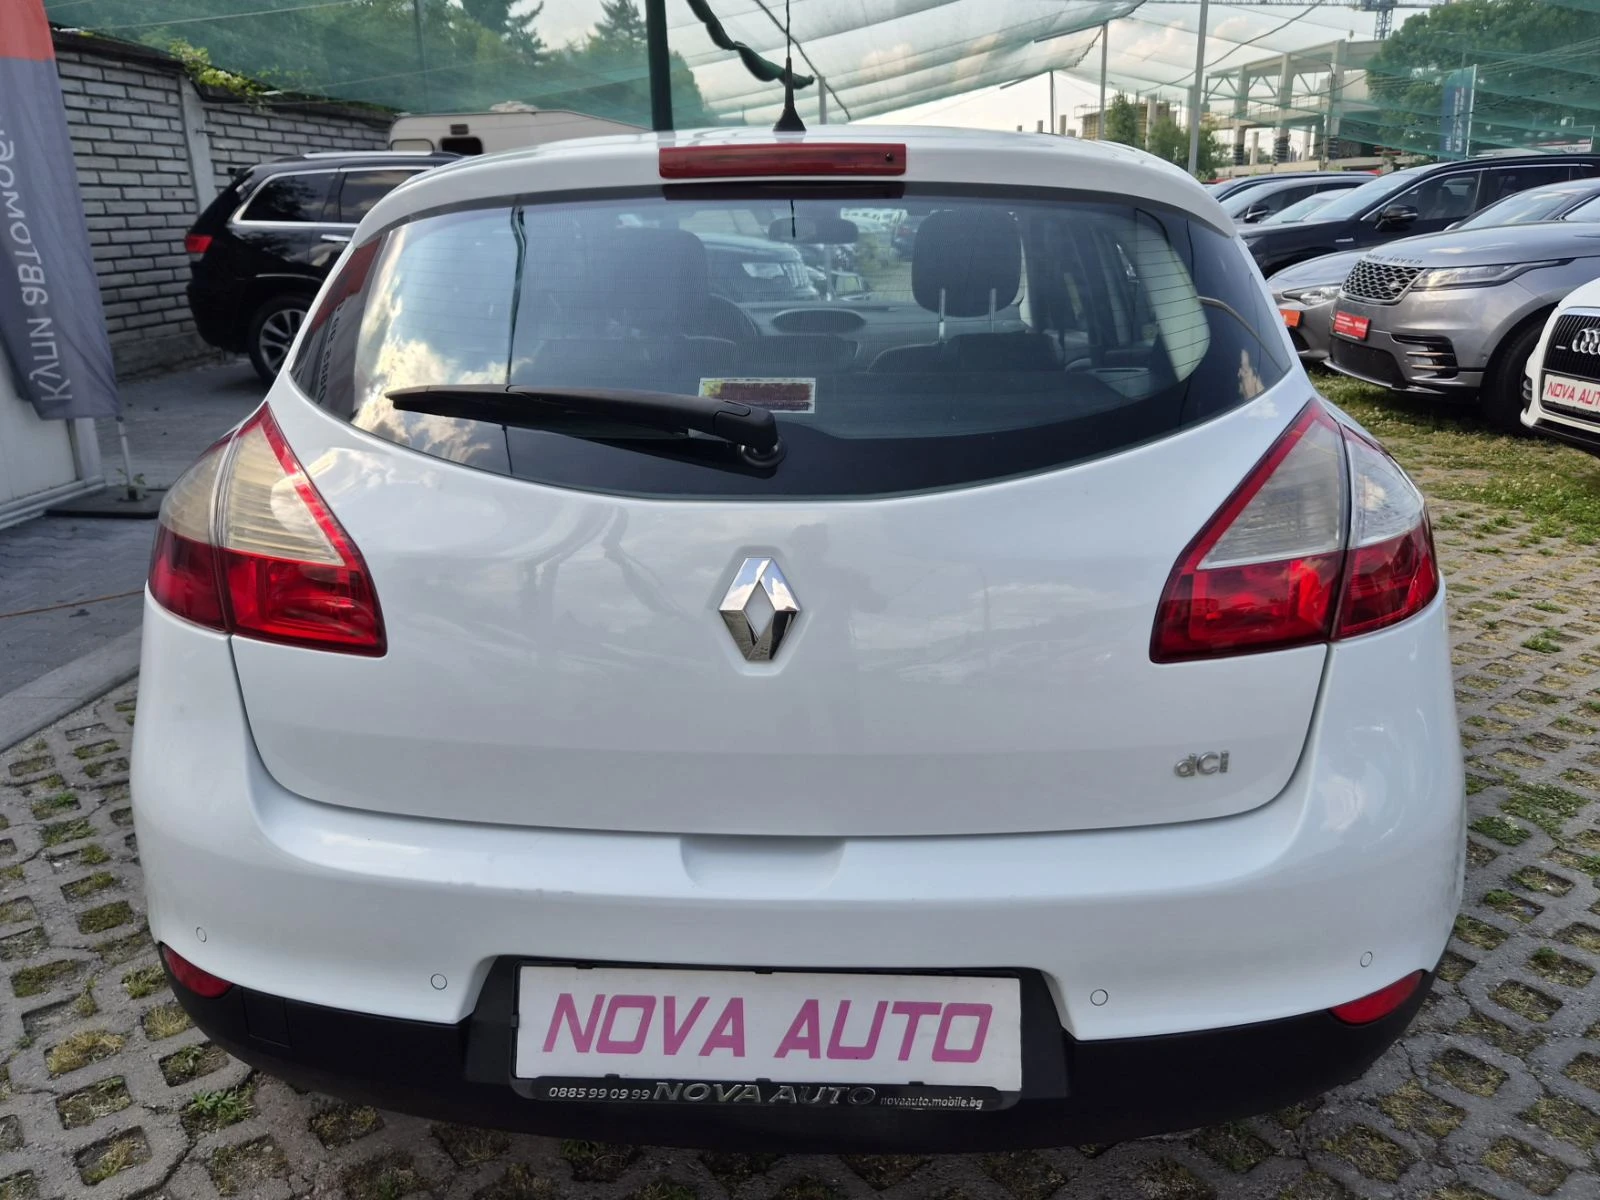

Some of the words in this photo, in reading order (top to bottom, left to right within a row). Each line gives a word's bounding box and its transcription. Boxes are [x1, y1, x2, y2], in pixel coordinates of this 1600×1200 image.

[1547, 382, 1575, 400] NOVA
[542, 993, 746, 1058] NOVA
[773, 999, 993, 1063] AUTO
[549, 1086, 587, 1099] 0885
[653, 1082, 763, 1103] NOVA
[768, 1085, 877, 1106] AUTO
[880, 1096, 984, 1110] novaauto.mobile.bg
